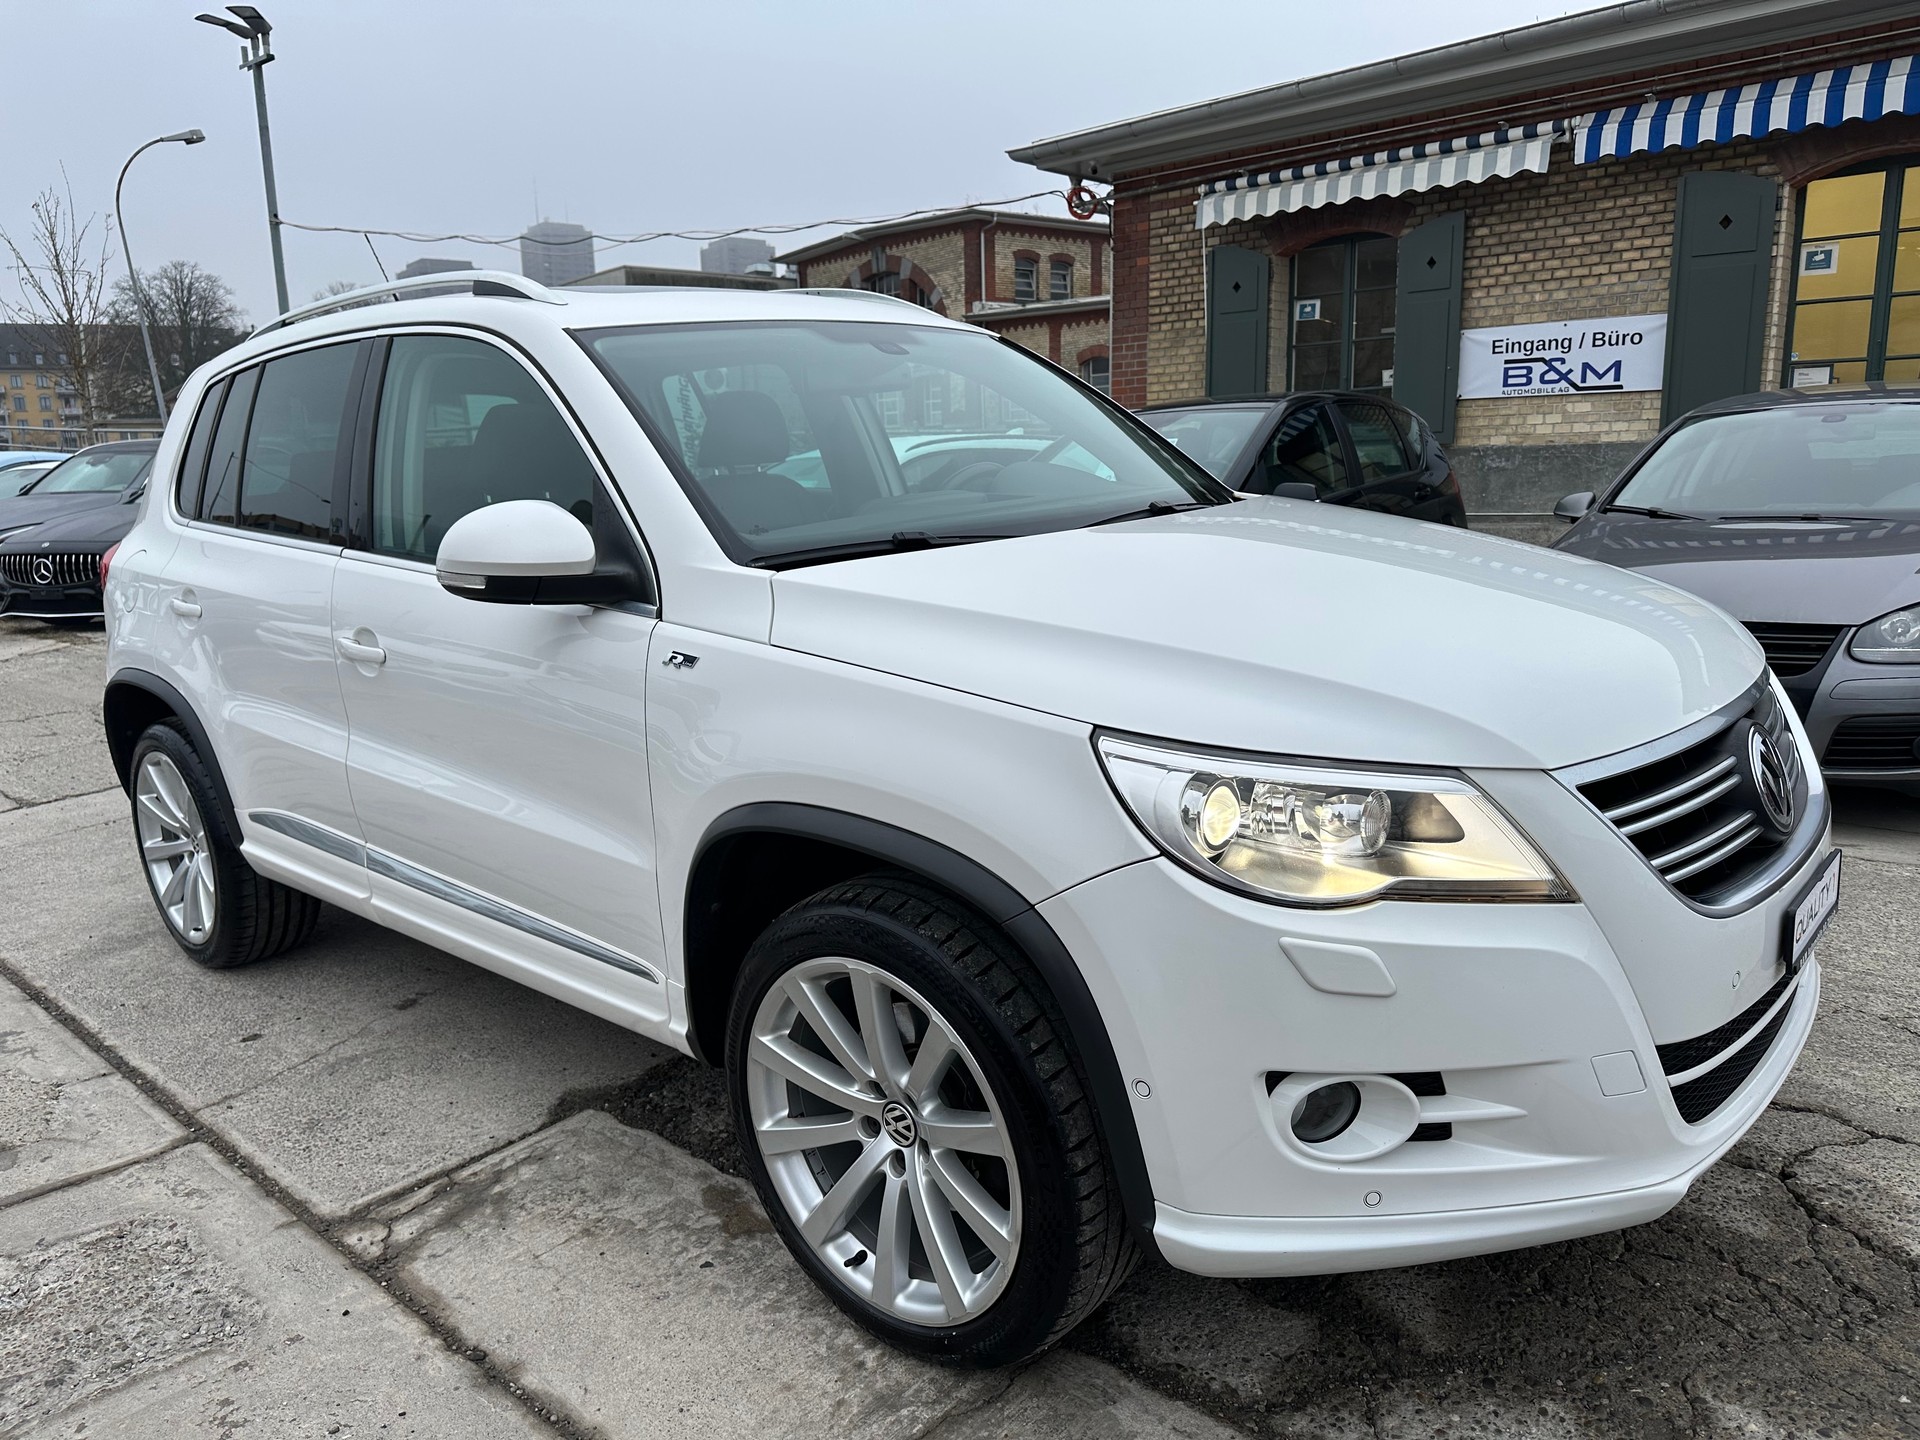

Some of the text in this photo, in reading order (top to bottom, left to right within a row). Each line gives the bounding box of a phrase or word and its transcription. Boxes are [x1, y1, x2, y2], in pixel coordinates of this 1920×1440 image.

[1491, 331, 1643, 356] Eingang / Büro
[1502, 357, 1622, 388] B&M
[1501, 386, 1570, 396] AUTOMOBILE AG
